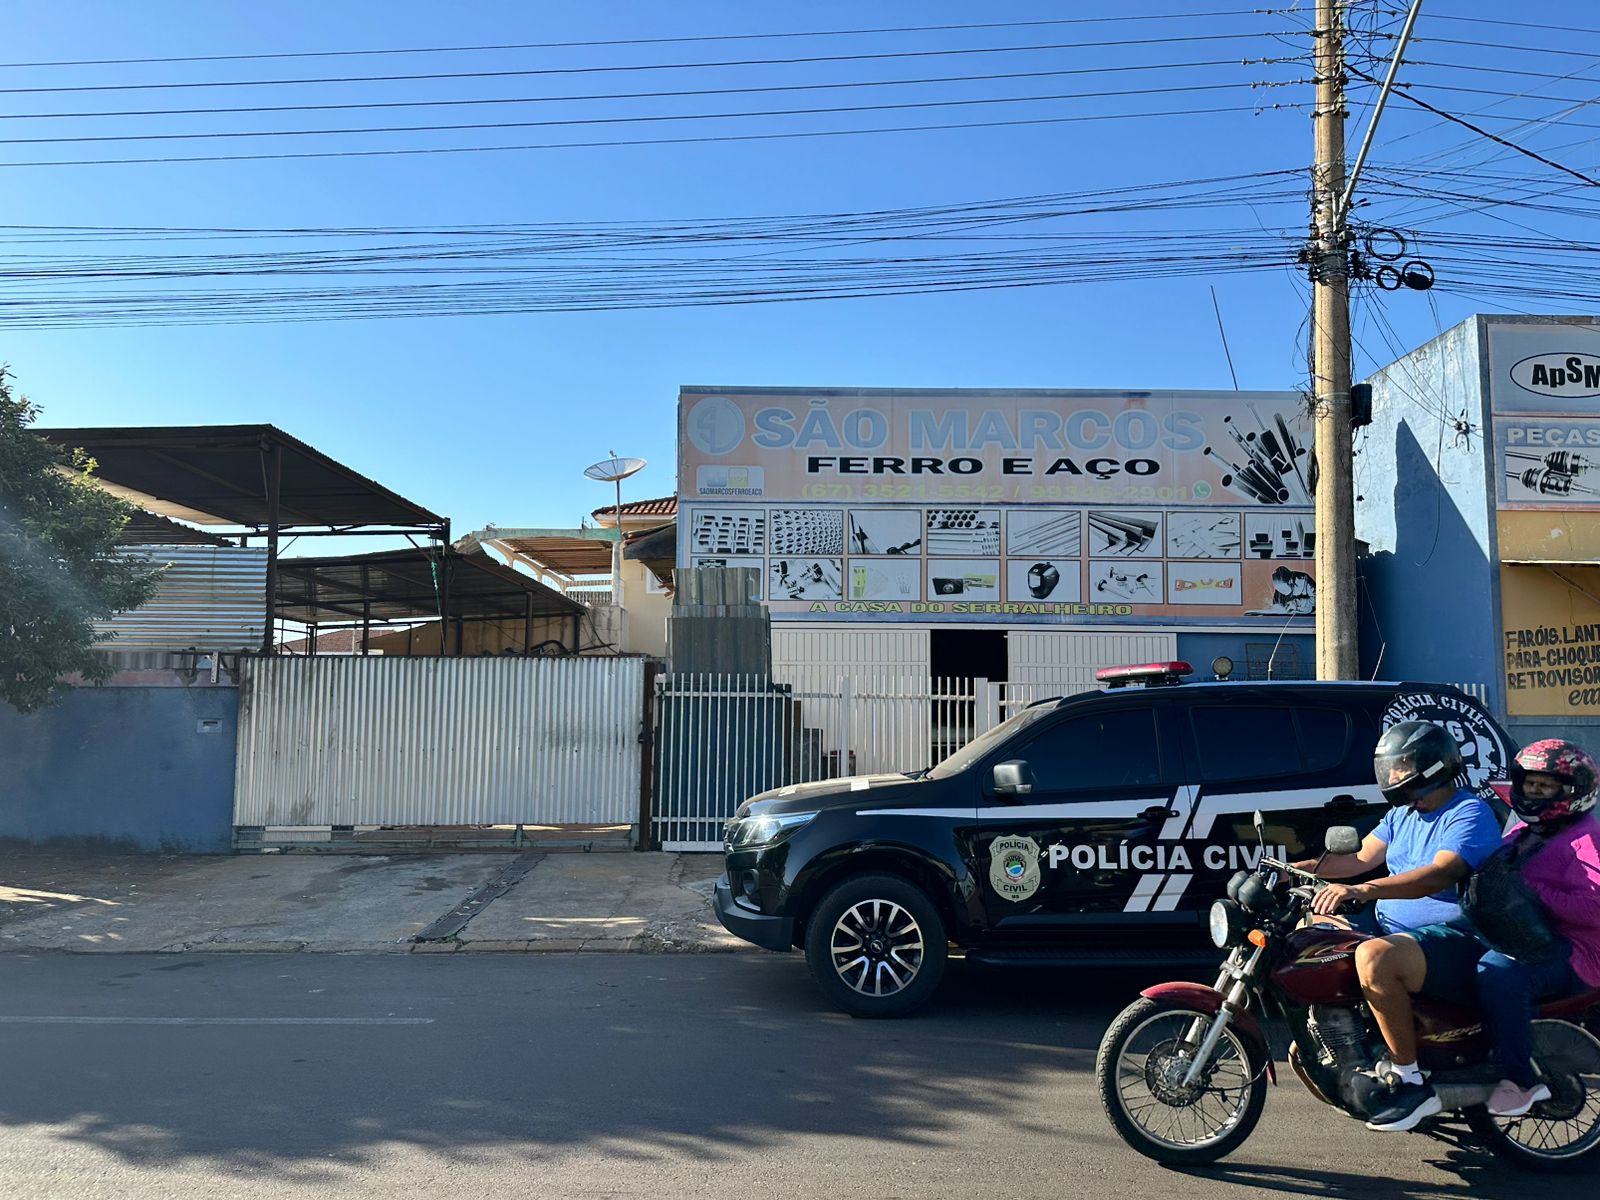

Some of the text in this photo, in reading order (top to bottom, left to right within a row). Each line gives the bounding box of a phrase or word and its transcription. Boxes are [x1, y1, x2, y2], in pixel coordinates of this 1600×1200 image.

[752, 399, 1206, 450] SÃO MARCOS
[807, 456, 1161, 480] FERRO E AÇO
[801, 483, 854, 499] (67)
[809, 602, 1133, 616] A CASA DO SERRALHEIRO
[1383, 694, 1437, 725] POLÍCIA
[1000, 841, 1029, 850] POLÍCIA
[1049, 839, 1194, 870] POLÍCIA
[1003, 884, 1028, 892] CIVIL
[1320, 953, 1350, 964] HONDA
